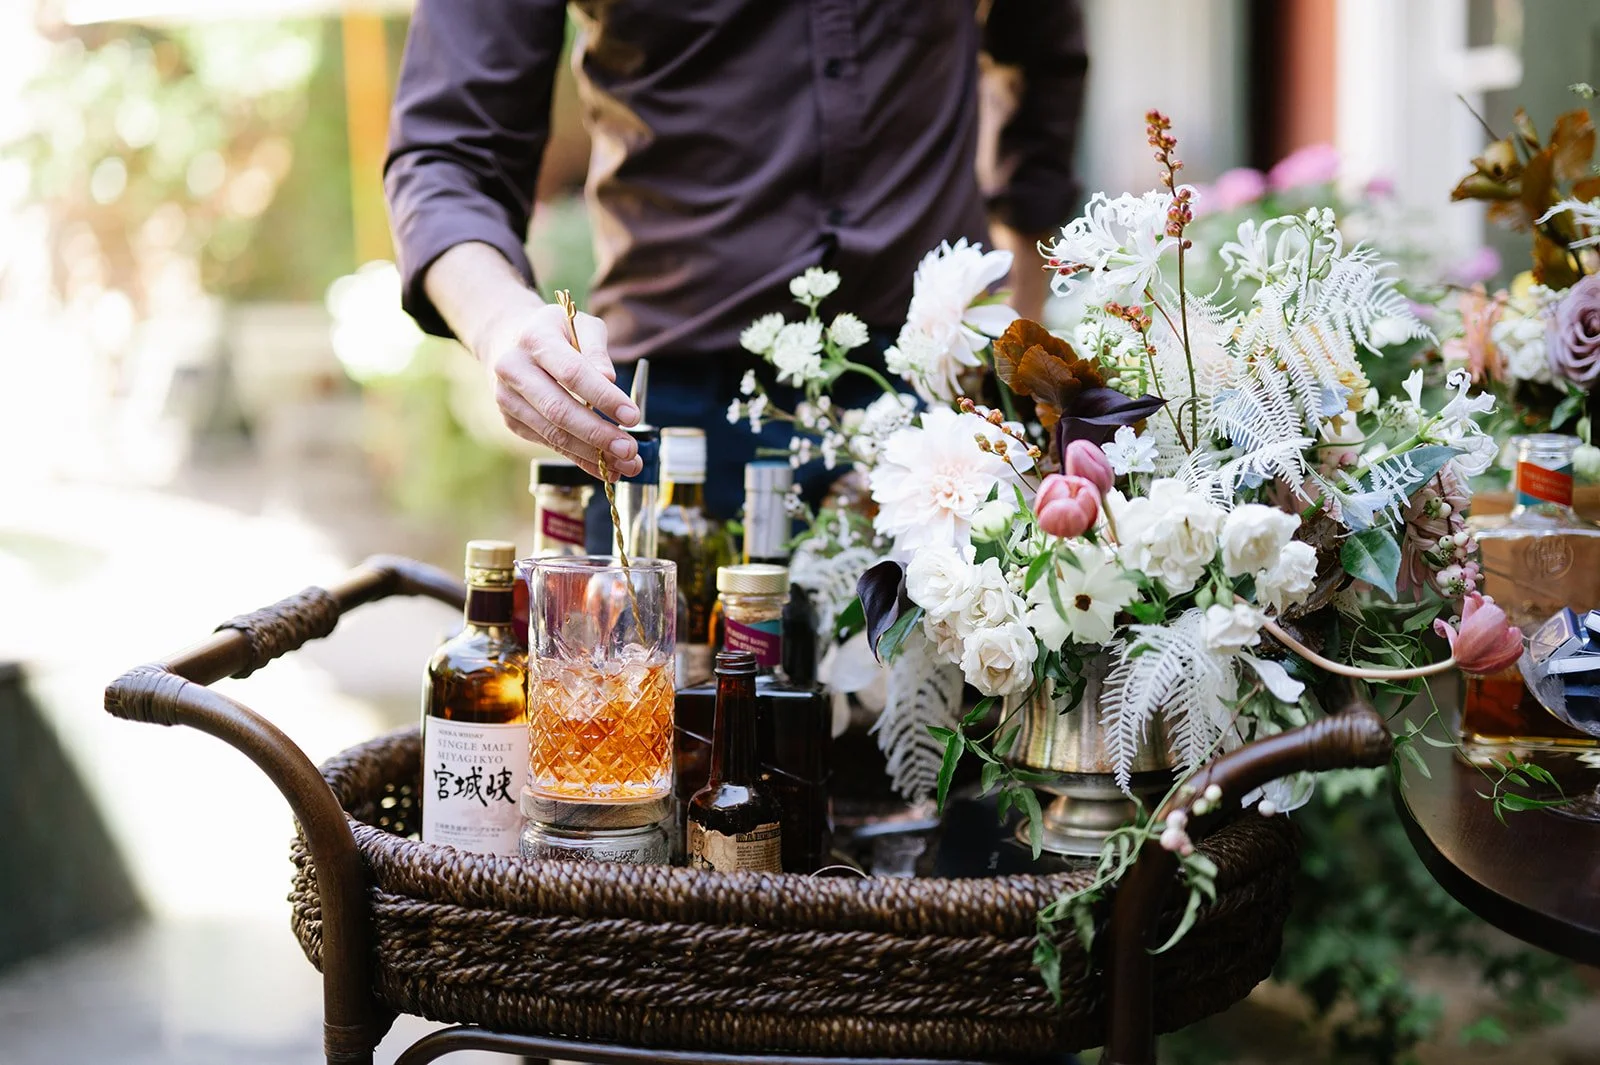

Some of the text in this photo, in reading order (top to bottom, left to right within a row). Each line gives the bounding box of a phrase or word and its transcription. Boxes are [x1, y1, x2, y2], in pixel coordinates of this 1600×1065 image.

[437, 739, 514, 752] SINGLE MALT
[437, 750, 504, 764] MIYAGIKYO
